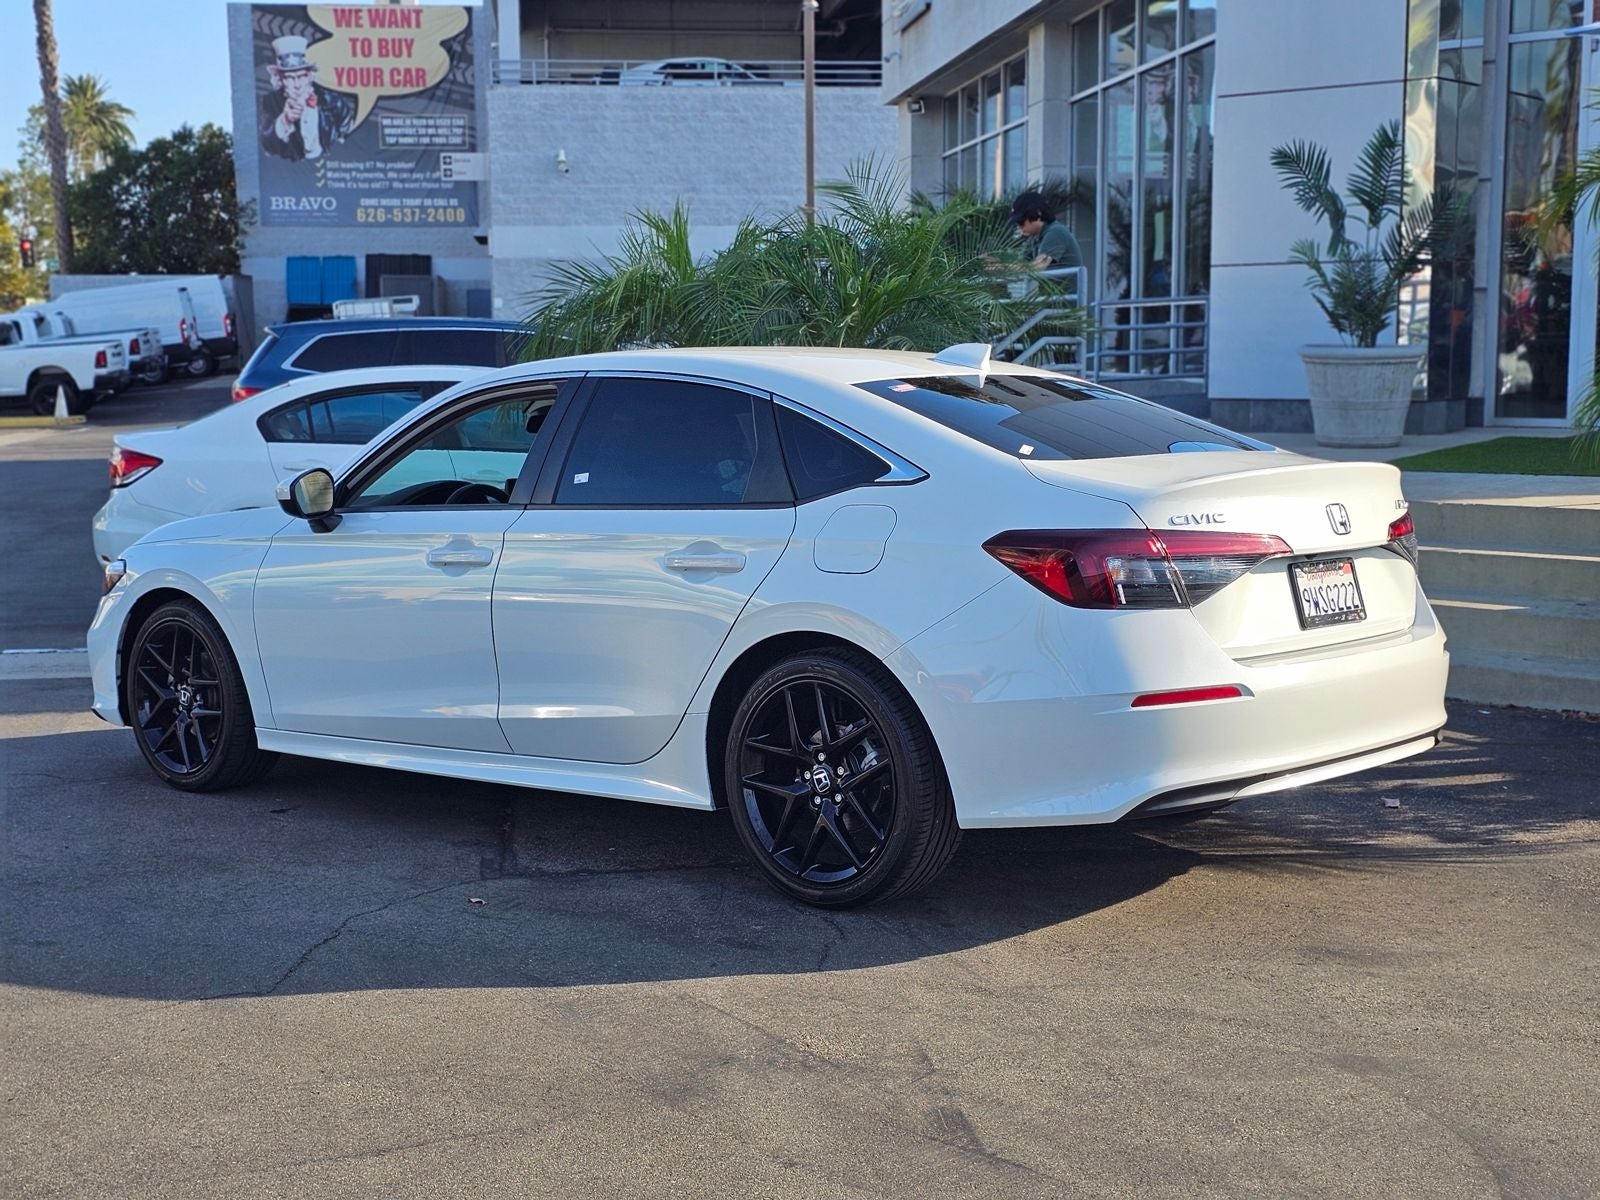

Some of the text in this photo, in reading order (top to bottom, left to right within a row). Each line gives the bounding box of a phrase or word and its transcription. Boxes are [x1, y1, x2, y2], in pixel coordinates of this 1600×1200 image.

[333, 8, 423, 29] WE WANT
[348, 37, 415, 58] TO BUY
[334, 66, 427, 88] YOUR CAR
[270, 196, 337, 210] BRAVO
[356, 207, 466, 222] 626-537-2400
[1168, 513, 1227, 526] CIVIC
[1302, 581, 1360, 618] 9WSG222
